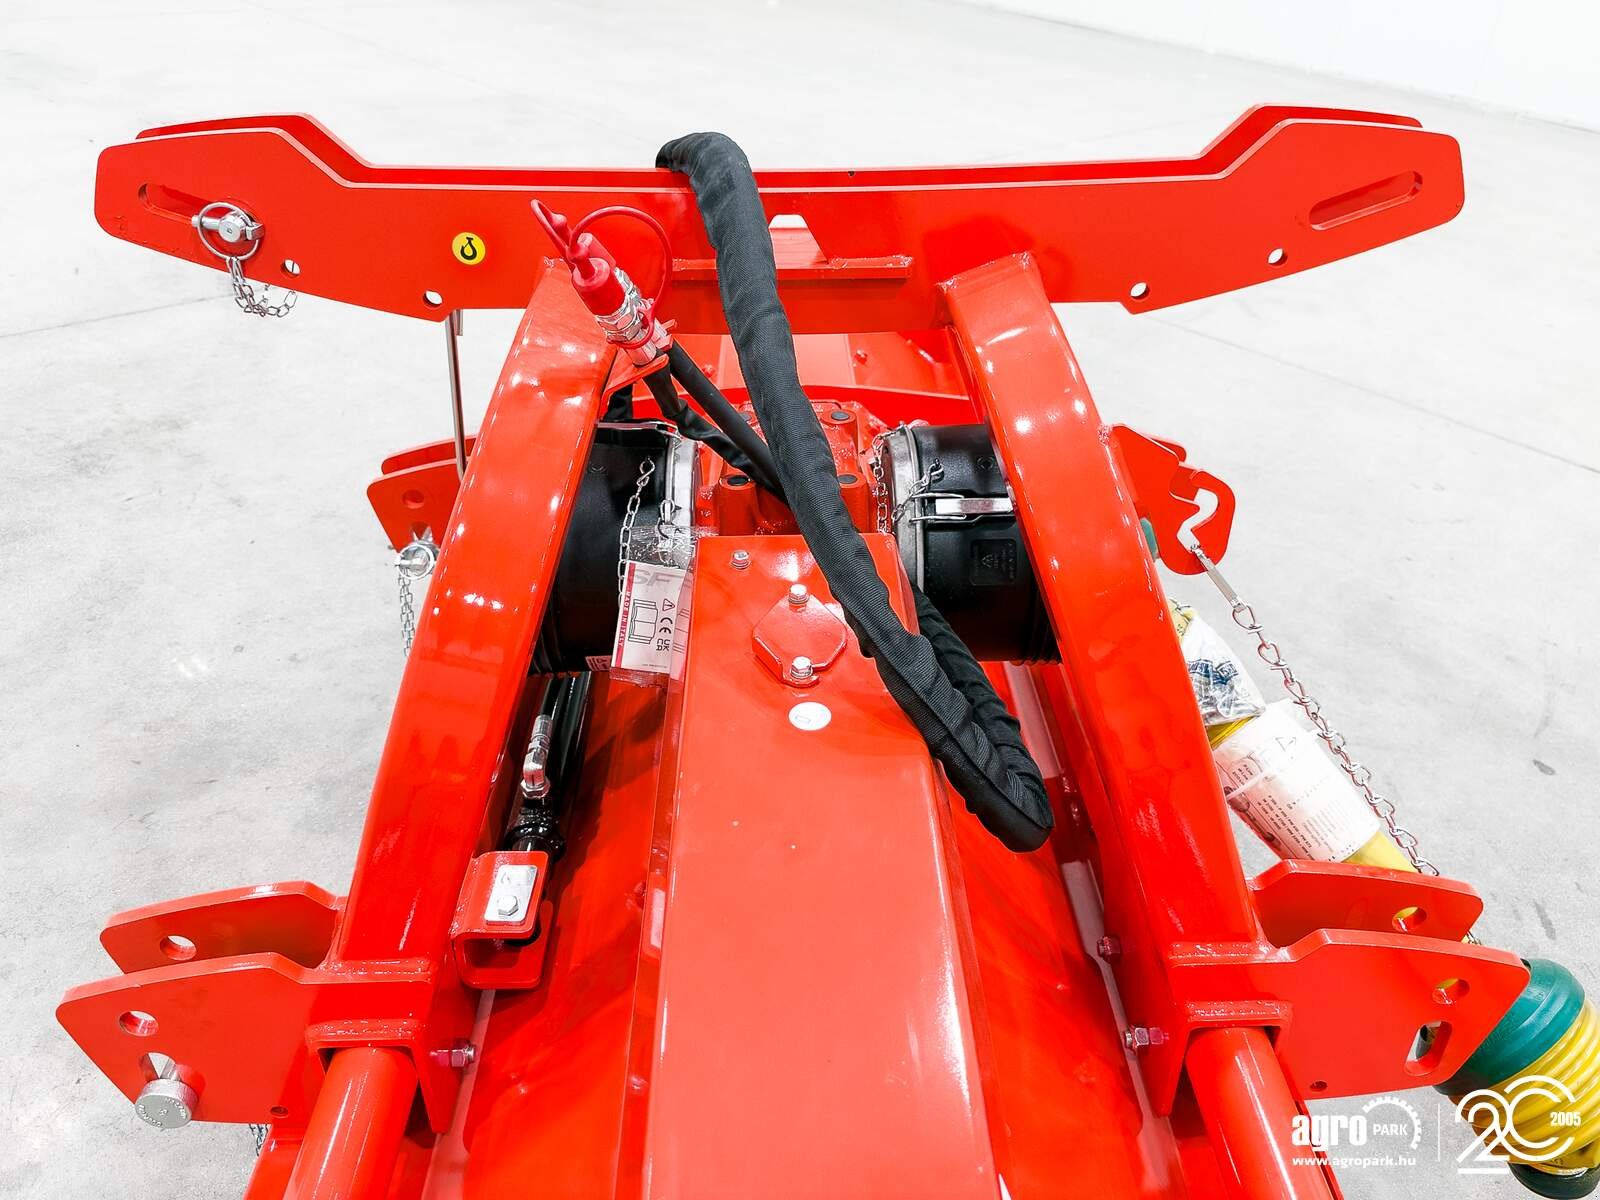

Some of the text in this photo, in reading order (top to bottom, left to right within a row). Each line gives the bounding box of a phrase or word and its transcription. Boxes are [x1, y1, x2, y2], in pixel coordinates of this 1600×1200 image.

[623, 591, 631, 611] MADE
[659, 617, 673, 634] CE
[618, 625, 626, 647] ITALY
